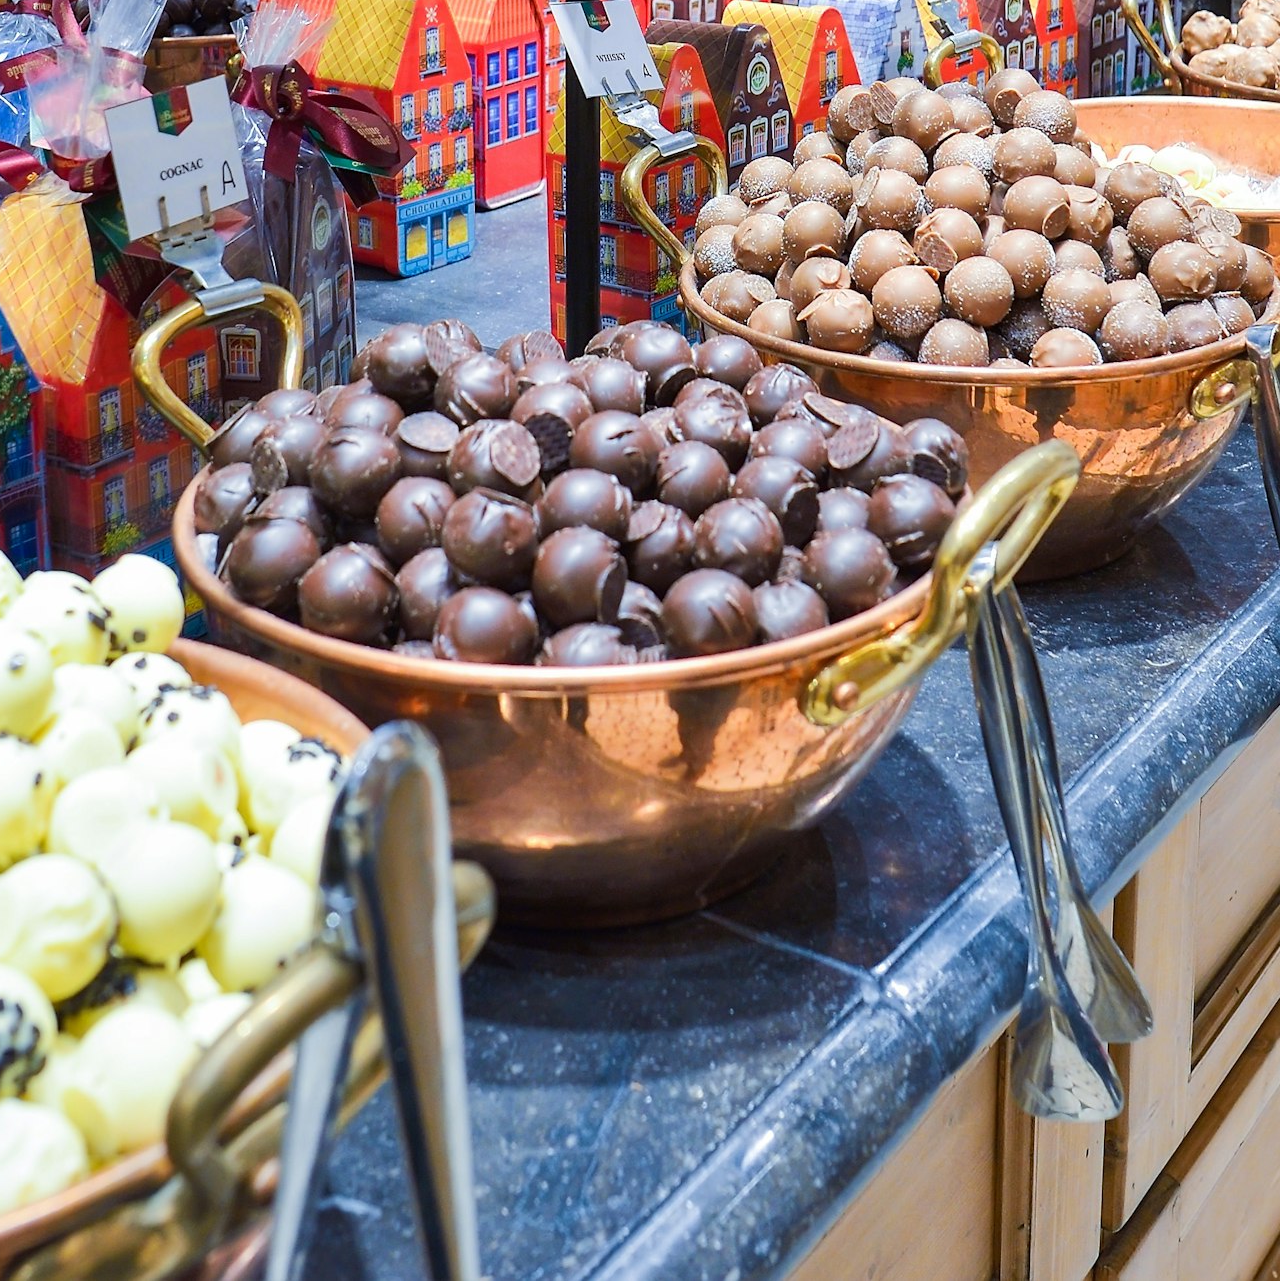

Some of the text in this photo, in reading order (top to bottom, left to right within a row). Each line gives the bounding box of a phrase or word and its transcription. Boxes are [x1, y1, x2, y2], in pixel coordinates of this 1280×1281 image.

[596, 52, 626, 63] WHISKY
[642, 63, 652, 79] A
[159, 158, 205, 182] COGNAC
[222, 160, 237, 196] A
[405, 191, 469, 218] CHOCOLATIER
